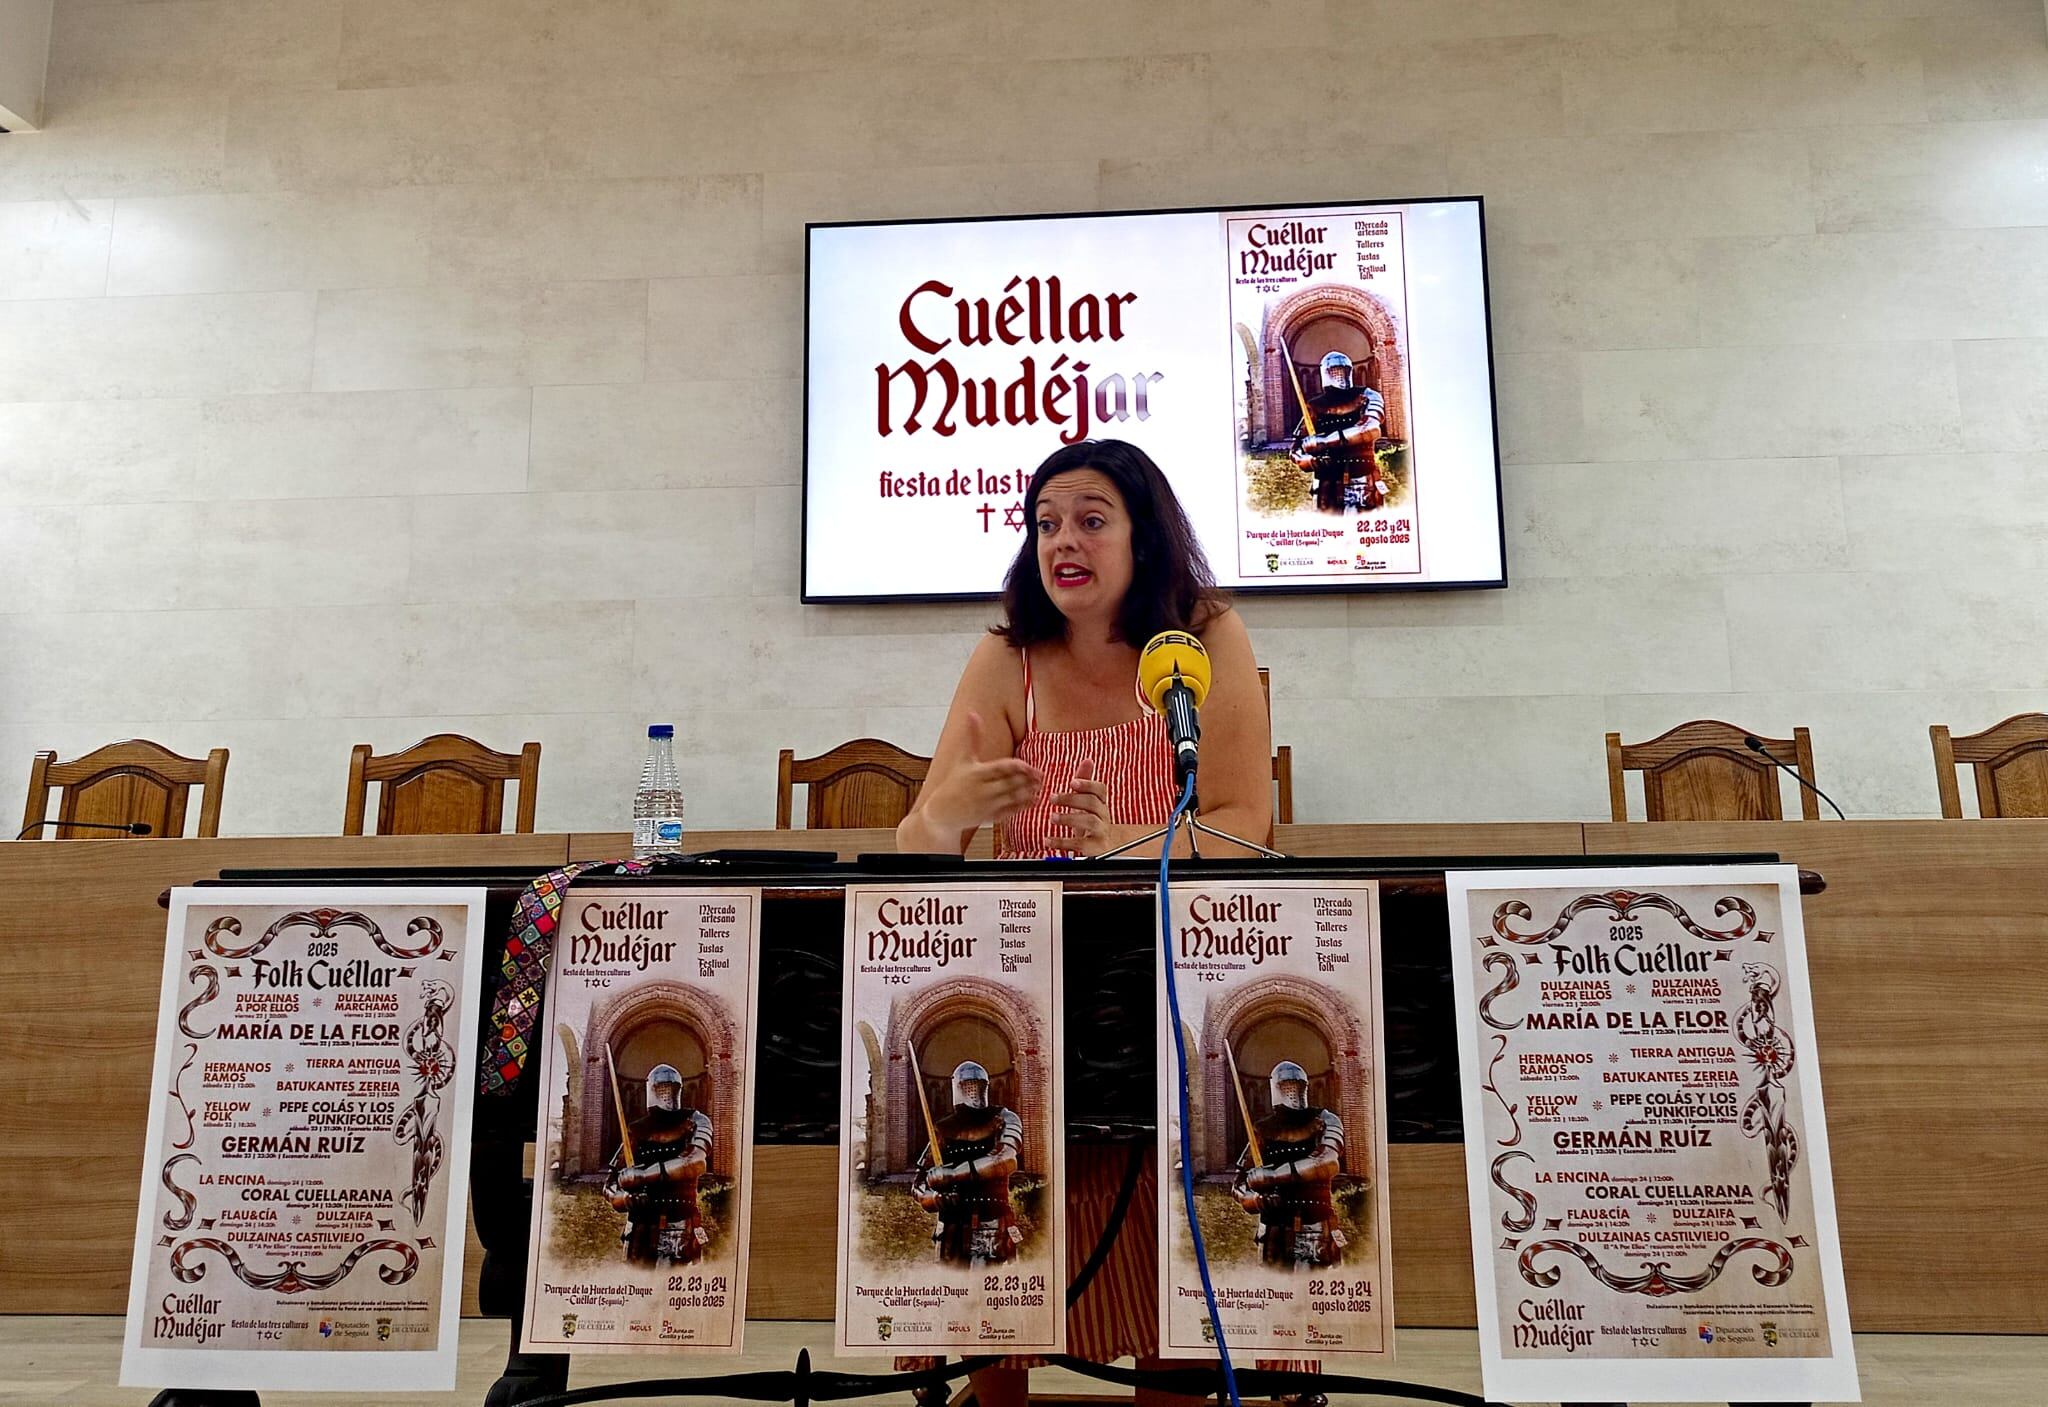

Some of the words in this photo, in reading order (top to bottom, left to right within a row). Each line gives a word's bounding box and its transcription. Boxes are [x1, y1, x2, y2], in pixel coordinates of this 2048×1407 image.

[1355, 221, 1388, 230] Mercado
[1248, 222, 1328, 248] Cuéllar
[1241, 248, 1337, 277] Mudéjar
[1357, 264, 1386, 273] Festival
[899, 275, 1137, 355] Cuéllar
[875, 354, 1164, 446] Mudéjar
[880, 471, 941, 497] fiesta
[946, 469, 971, 495] de
[977, 468, 1011, 495] las
[1375, 520, 1387, 532] 23
[1390, 524, 1395, 533] y
[1396, 519, 1410, 531] 24
[1360, 536, 1388, 546] agosto
[1390, 535, 1409, 543] 2025
[1000, 899, 1036, 909] Mercado
[1314, 898, 1351, 908] Mercado
[700, 905, 735, 915] Mercado
[878, 897, 968, 928] Cuéllar
[1190, 894, 1282, 925] Cuéllar
[1317, 908, 1352, 916] artesano
[581, 902, 669, 932] Cuéllar
[702, 915, 735, 923] artesano
[999, 923, 1031, 933] Talleres
[1315, 921, 1348, 931] Talleres
[699, 929, 729, 938] Talleres
[1610, 926, 1643, 940] 2025
[1000, 938, 1025, 948] Justas
[1180, 926, 1292, 965] Mudéjar
[1315, 936, 1342, 947] Justas
[308, 943, 338, 956] 2025
[571, 935, 677, 971] Mudéjar
[698, 943, 723, 953] Justas
[868, 930, 977, 967] Mudéjar
[999, 953, 1031, 963] Festival
[1316, 952, 1349, 962] Festival
[1548, 944, 1608, 975] Folk
[1614, 944, 1712, 976] Cuéllar
[698, 959, 729, 968] Festival
[1002, 964, 1017, 972] folk
[1319, 962, 1334, 972] folk
[251, 959, 303, 989] Folk
[307, 959, 399, 990] Cuéllar
[700, 968, 714, 977] folk
[1541, 981, 1609, 991] DULZAINAS
[1653, 979, 1718, 988] DULZAINAS
[237, 994, 299, 1002] DULZAINAS
[338, 994, 398, 1002] DULZAINAS
[1542, 991, 1551, 999] A
[1553, 991, 1574, 999] POR
[1575, 990, 1612, 999] ELLOS
[1651, 988, 1721, 997] MARCHAMO
[235, 1004, 243, 1012] A
[246, 1004, 264, 1012] POR
[266, 1004, 299, 1012] ELLOS
[335, 1003, 399, 1011] MARCHAMO
[1527, 1009, 1599, 1030] MARÍA
[1607, 1013, 1632, 1029] DE
[1640, 1012, 1669, 1028] LA
[1675, 1012, 1728, 1027] FLOR
[217, 1020, 281, 1039] MARÍA
[290, 1025, 315, 1039] DE
[322, 1025, 346, 1039] LA
[352, 1025, 399, 1040] FLOR
[1630, 1048, 1672, 1058] TIERRA
[1677, 1047, 1735, 1058] ANTIGUA
[306, 1059, 344, 1068] TIERRA
[348, 1059, 400, 1068] ANTIGUA
[1519, 1054, 1593, 1064] HERMANOS
[204, 1063, 271, 1072] HERMANOS
[1520, 1065, 1567, 1074] RAMOS
[204, 1073, 245, 1082] RAMOS
[1603, 1072, 1688, 1083] BATUKANTES
[1693, 1071, 1738, 1081] ZEREIA
[277, 1082, 354, 1091] BATUKANTES
[359, 1082, 400, 1091] ZEREIA
[1526, 1096, 1577, 1105] YELLOW
[1611, 1094, 1642, 1105] PEPE
[1646, 1091, 1691, 1105] COLÁS
[1695, 1094, 1704, 1104] Y
[1708, 1093, 1736, 1104] LOS
[205, 1103, 251, 1111] YELLOW
[280, 1103, 314, 1112] PEPE
[317, 1099, 354, 1112] COLÁS
[357, 1103, 366, 1112] Y
[369, 1103, 395, 1113] LOS
[1528, 1106, 1560, 1115] FOLK
[204, 1112, 232, 1120] FOLK
[1644, 1106, 1738, 1118] PUNKIFOLKIS
[308, 1115, 393, 1124] PUNKIFOLKIS
[1554, 1126, 1655, 1148] GERMÁN
[1661, 1126, 1711, 1147] RUÍZ
[222, 1133, 309, 1153] GERMÁN
[318, 1133, 365, 1153] RUÍZ
[200, 1175, 215, 1185] LA
[218, 1175, 266, 1185] ENCINA
[1535, 1173, 1552, 1183] LA
[1557, 1172, 1609, 1183] ENCINA
[241, 1189, 289, 1201] CORAL
[295, 1189, 393, 1201] CUELLARANA
[1586, 1186, 1639, 1199] CORAL
[1645, 1185, 1752, 1198] CUELLARANA
[221, 1208, 277, 1220] FLAU&CÍA
[316, 1211, 373, 1220] DULZAIFA
[1567, 1207, 1629, 1220] FLAU&CÍA
[1673, 1209, 1734, 1218] DULZAIFA
[228, 1232, 292, 1242] DULZAINAS
[296, 1233, 364, 1242] CASTILVIEJO
[1579, 1232, 1650, 1242] DULZAINAS
[1655, 1231, 1729, 1241] CASTILVIEJO
[688, 1276, 701, 1290] 23
[704, 1283, 710, 1294] y
[711, 1277, 726, 1292] 24
[1005, 1276, 1019, 1291] 23
[1022, 1282, 1028, 1293] y
[1029, 1276, 1045, 1291] 24
[1330, 1281, 1345, 1295] 23
[1348, 1287, 1353, 1298] y
[1355, 1281, 1371, 1296] 24
[856, 1286, 884, 1298] Parque
[885, 1288, 893, 1296] de
[894, 1287, 902, 1296] la
[903, 1286, 929, 1296] Huerta
[931, 1286, 941, 1296] del
[943, 1286, 968, 1298] Duque
[163, 1293, 221, 1315] Cuéllar
[669, 1296, 700, 1310] agosto
[702, 1296, 724, 1307] 2025
[987, 1295, 1019, 1310] agosto
[1021, 1295, 1043, 1306] 2025
[1312, 1300, 1345, 1314] agosto
[1348, 1300, 1370, 1312] 2025
[1518, 1300, 1586, 1321] Cuéllar
[154, 1317, 225, 1344] Mudéjar
[1513, 1324, 1595, 1351] Mudéjar
